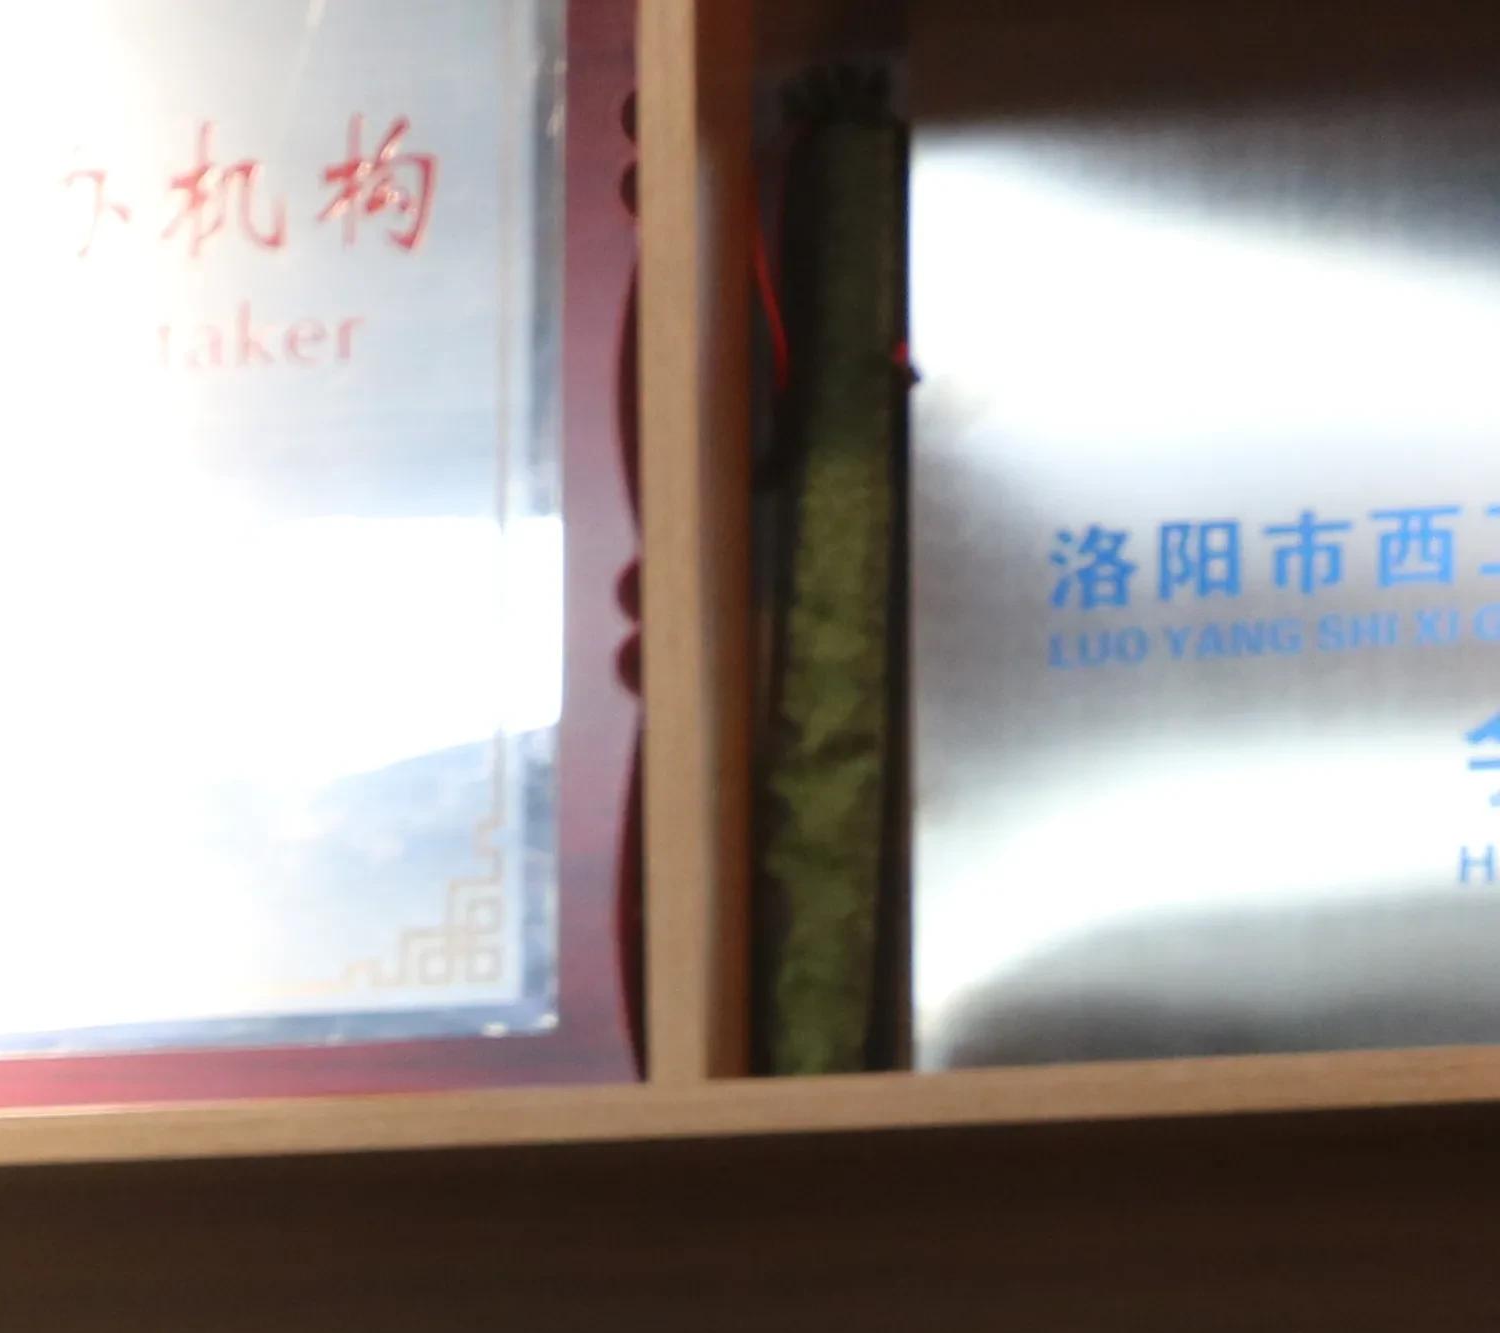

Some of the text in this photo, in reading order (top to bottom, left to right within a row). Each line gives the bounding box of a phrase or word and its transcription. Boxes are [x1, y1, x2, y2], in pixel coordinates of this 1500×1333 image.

[1048, 502, 1500, 612] 洛阳市西
[1048, 627, 1150, 668] LUO
[1163, 615, 1302, 662] YANG
[1317, 610, 1398, 652] SHI
[1414, 607, 1461, 648] XI
